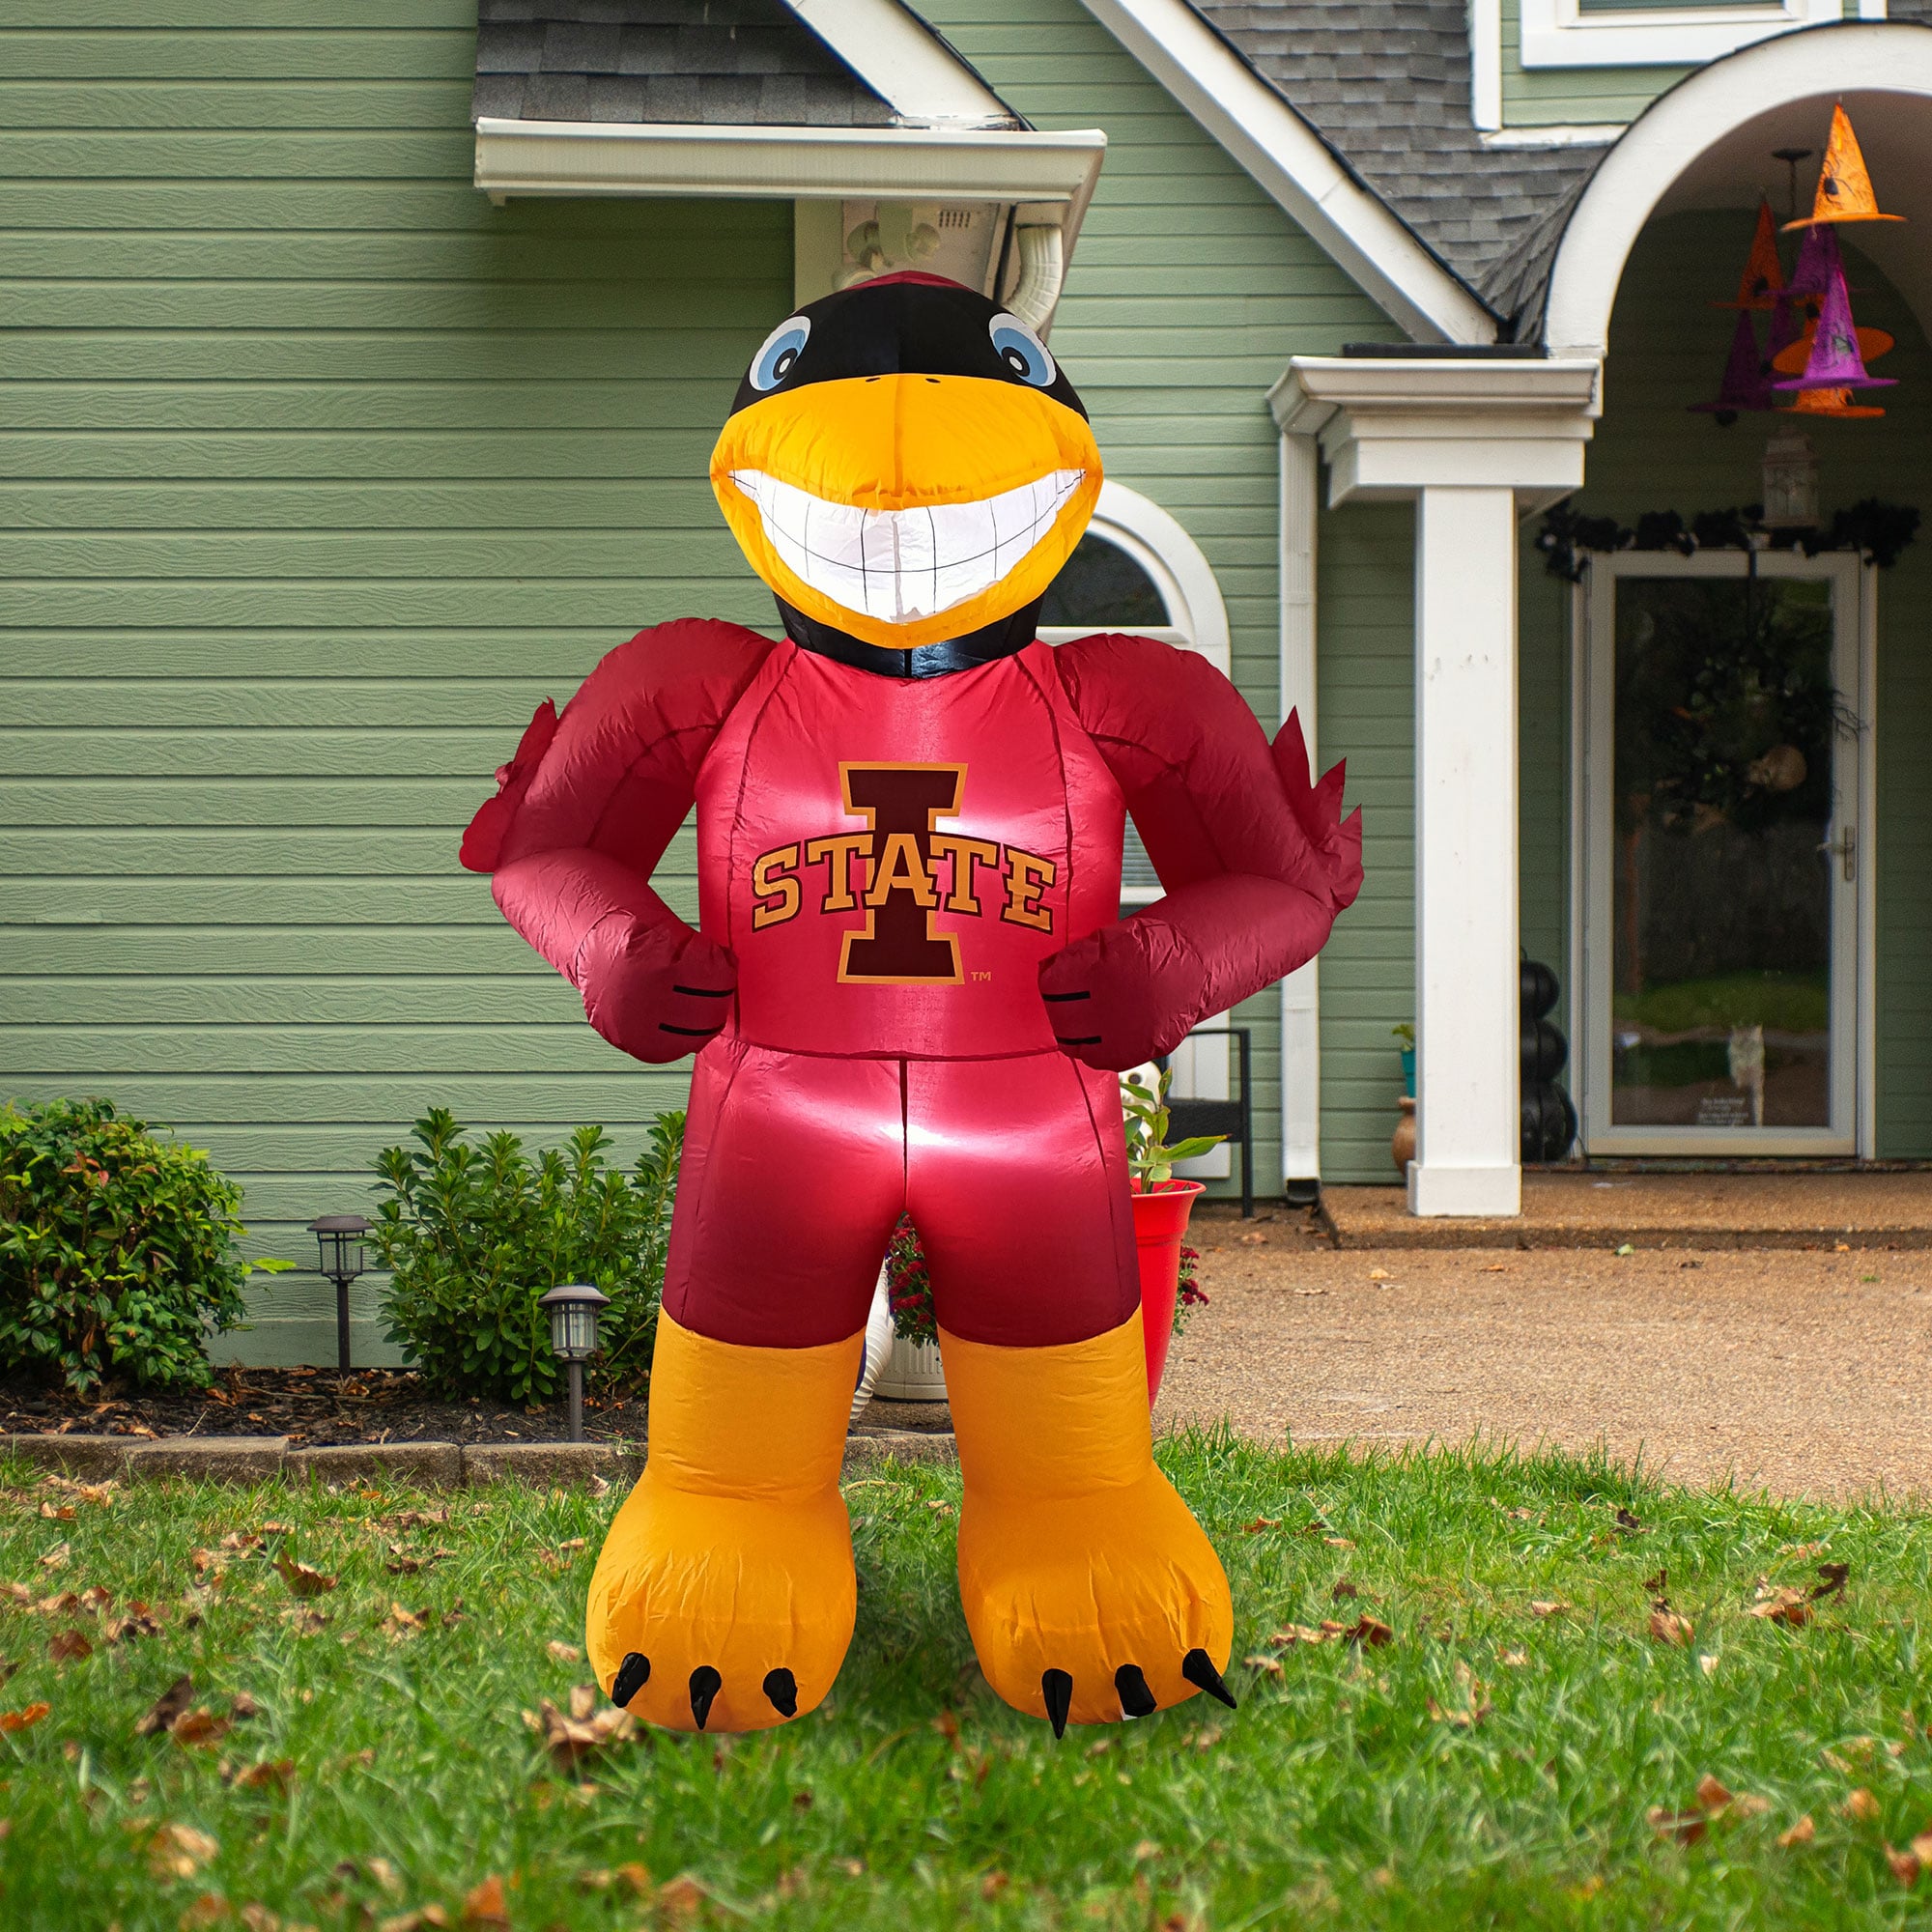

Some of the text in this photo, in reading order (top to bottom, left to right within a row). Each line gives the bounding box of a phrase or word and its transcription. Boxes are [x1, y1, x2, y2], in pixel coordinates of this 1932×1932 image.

[752, 830, 1056, 935] STATE
[837, 761, 968, 985] I
[970, 971, 992, 981] TM
